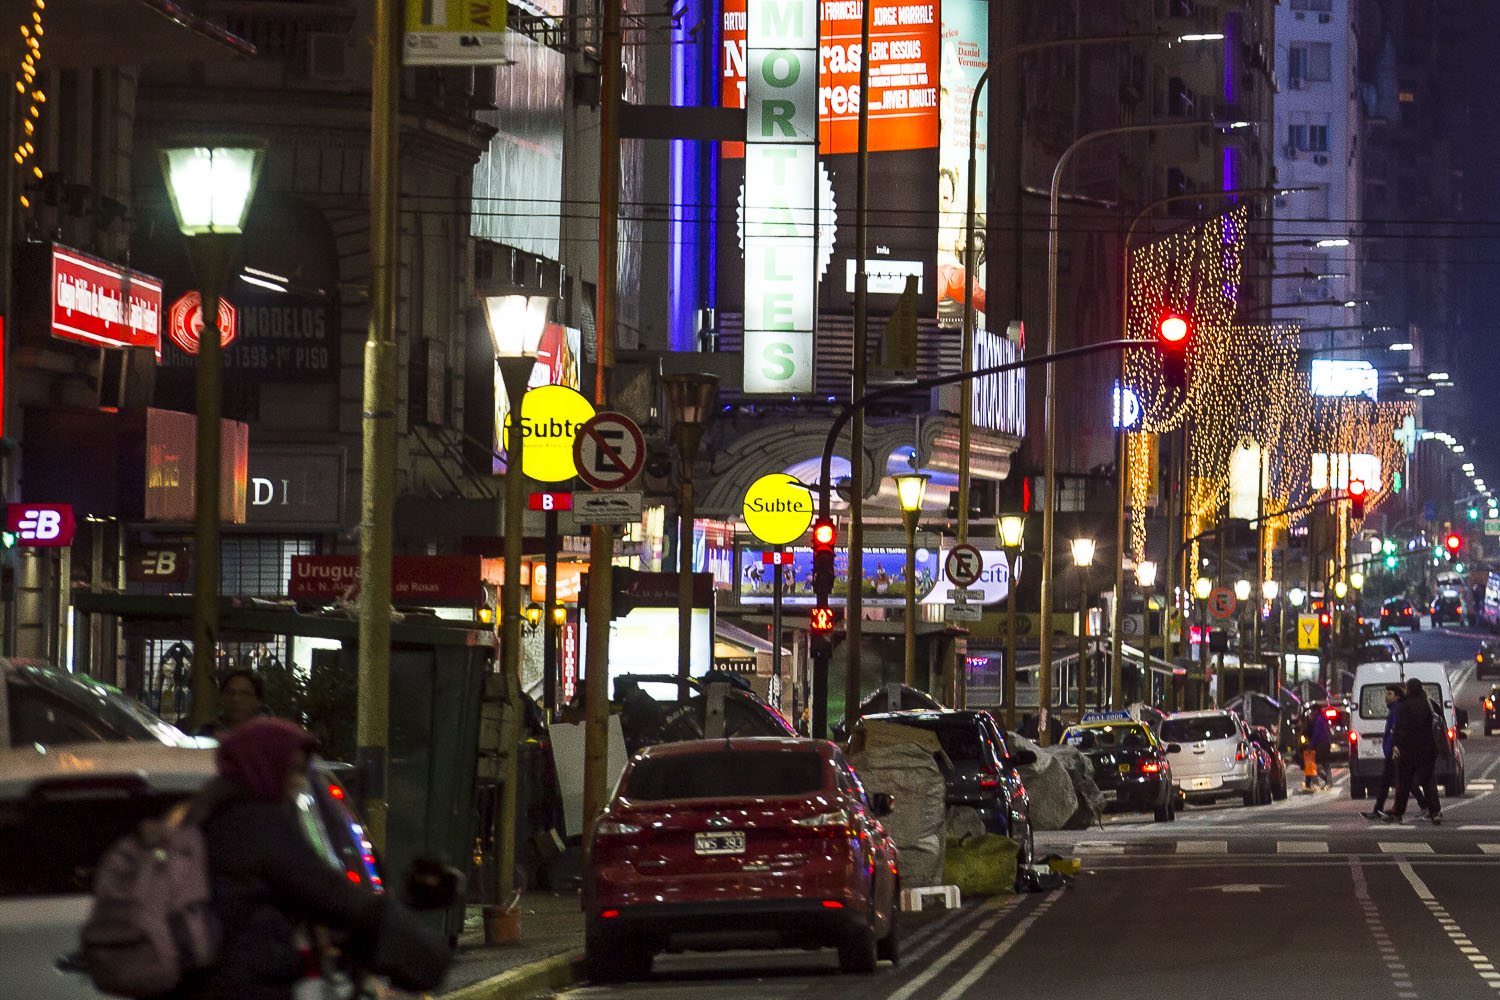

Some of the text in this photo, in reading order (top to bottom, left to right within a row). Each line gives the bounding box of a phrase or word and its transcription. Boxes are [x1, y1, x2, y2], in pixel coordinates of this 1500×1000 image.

[824, 0, 863, 21] FRANCELL
[873, 4, 934, 26] JORGE MARRALE
[890, 40, 921, 59] ASSOUS
[958, 47, 980, 58] Daniel
[908, 88, 937, 108] DAULTE
[541, 493, 554, 510] B
[753, 497, 803, 513] Subte
[773, 552, 782, 565] B
[296, 562, 362, 581] Urugua
[410, 582, 440, 592] Rosas
